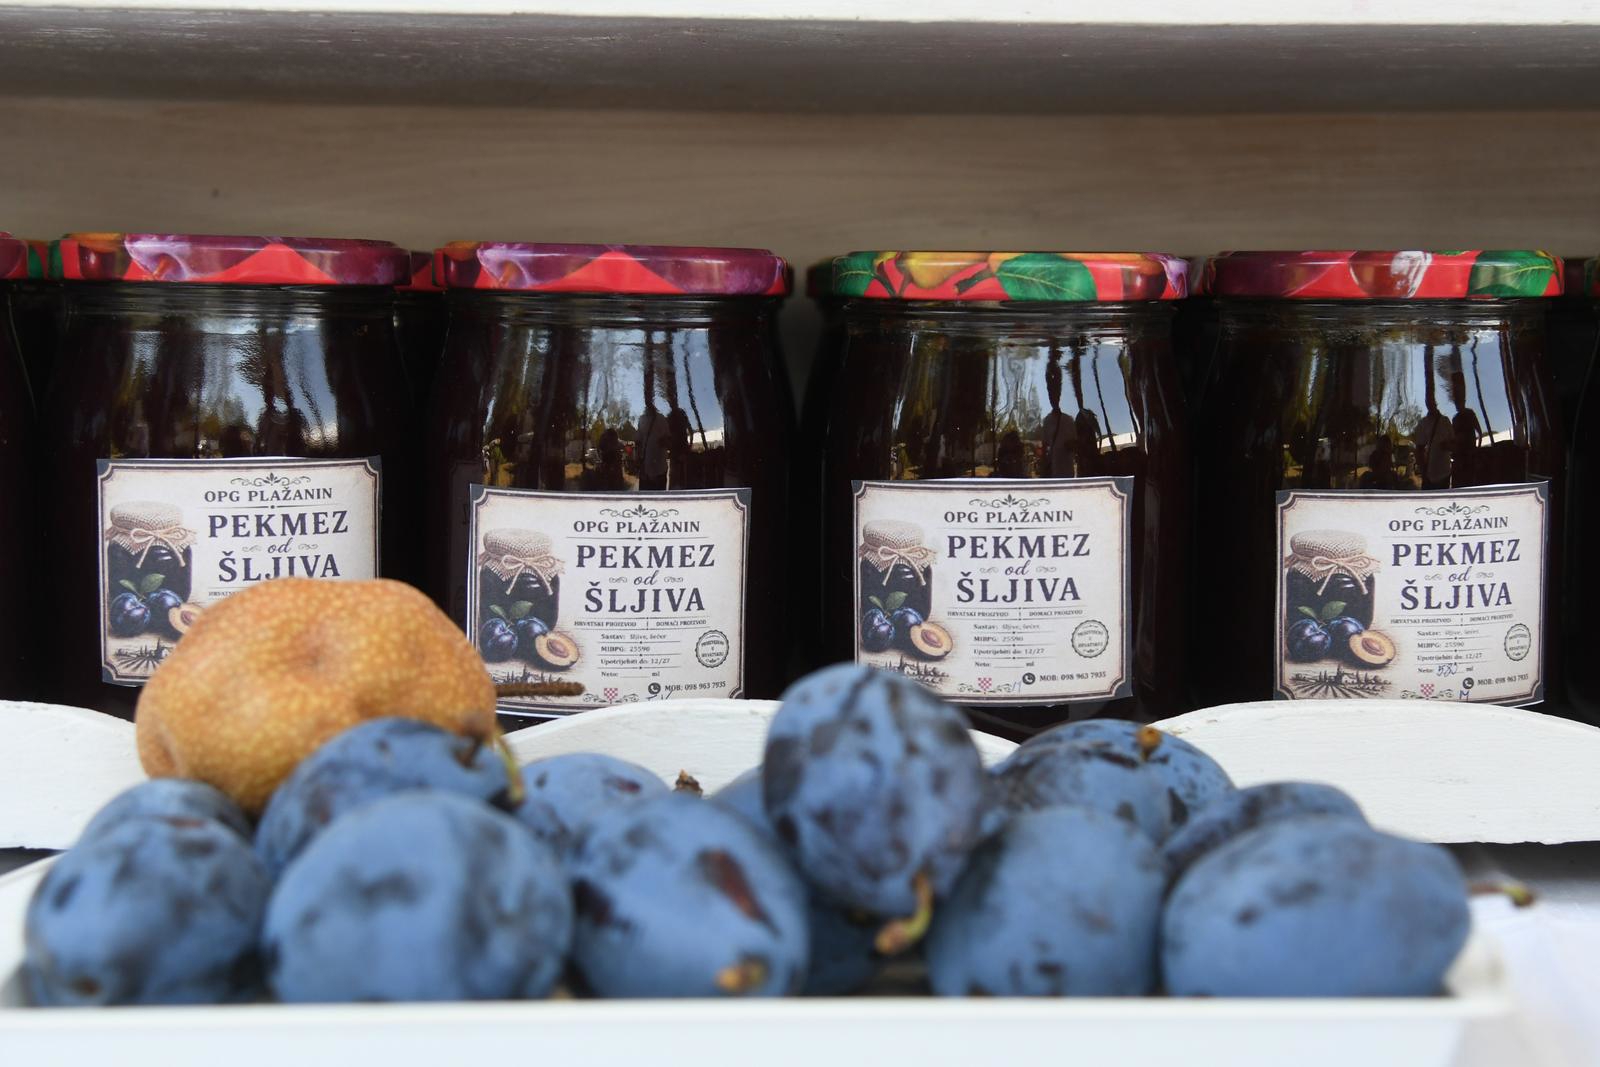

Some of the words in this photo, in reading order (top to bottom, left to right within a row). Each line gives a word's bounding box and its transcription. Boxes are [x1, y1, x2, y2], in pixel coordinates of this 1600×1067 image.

[204, 490, 240, 503] OPG
[247, 486, 333, 502] PLAŽANIN
[208, 510, 349, 538] PEKMEZ
[944, 511, 979, 523] OPG
[986, 508, 1074, 523] PLAŽANIN
[1388, 519, 1424, 532] OPG
[1431, 516, 1508, 531] PLAŽANIN
[573, 520, 609, 533] OPG
[616, 518, 700, 533] PLAŽANIN
[267, 537, 293, 554] od
[947, 533, 1091, 559] PEKMEZ
[1391, 538, 1521, 567] PEKMEZ
[576, 544, 715, 569] PEKMEZ
[218, 551, 341, 582] ŠLJIVA
[1005, 559, 1032, 575] od
[1448, 566, 1473, 582] od
[633, 570, 659, 585] od
[956, 571, 1081, 602] ŠLJIVA
[1400, 579, 1512, 611] ŠLJIVA
[584, 581, 706, 613] ŠLJIVA
[664, 684, 683, 692] MOB:
[684, 683, 697, 691] 098
